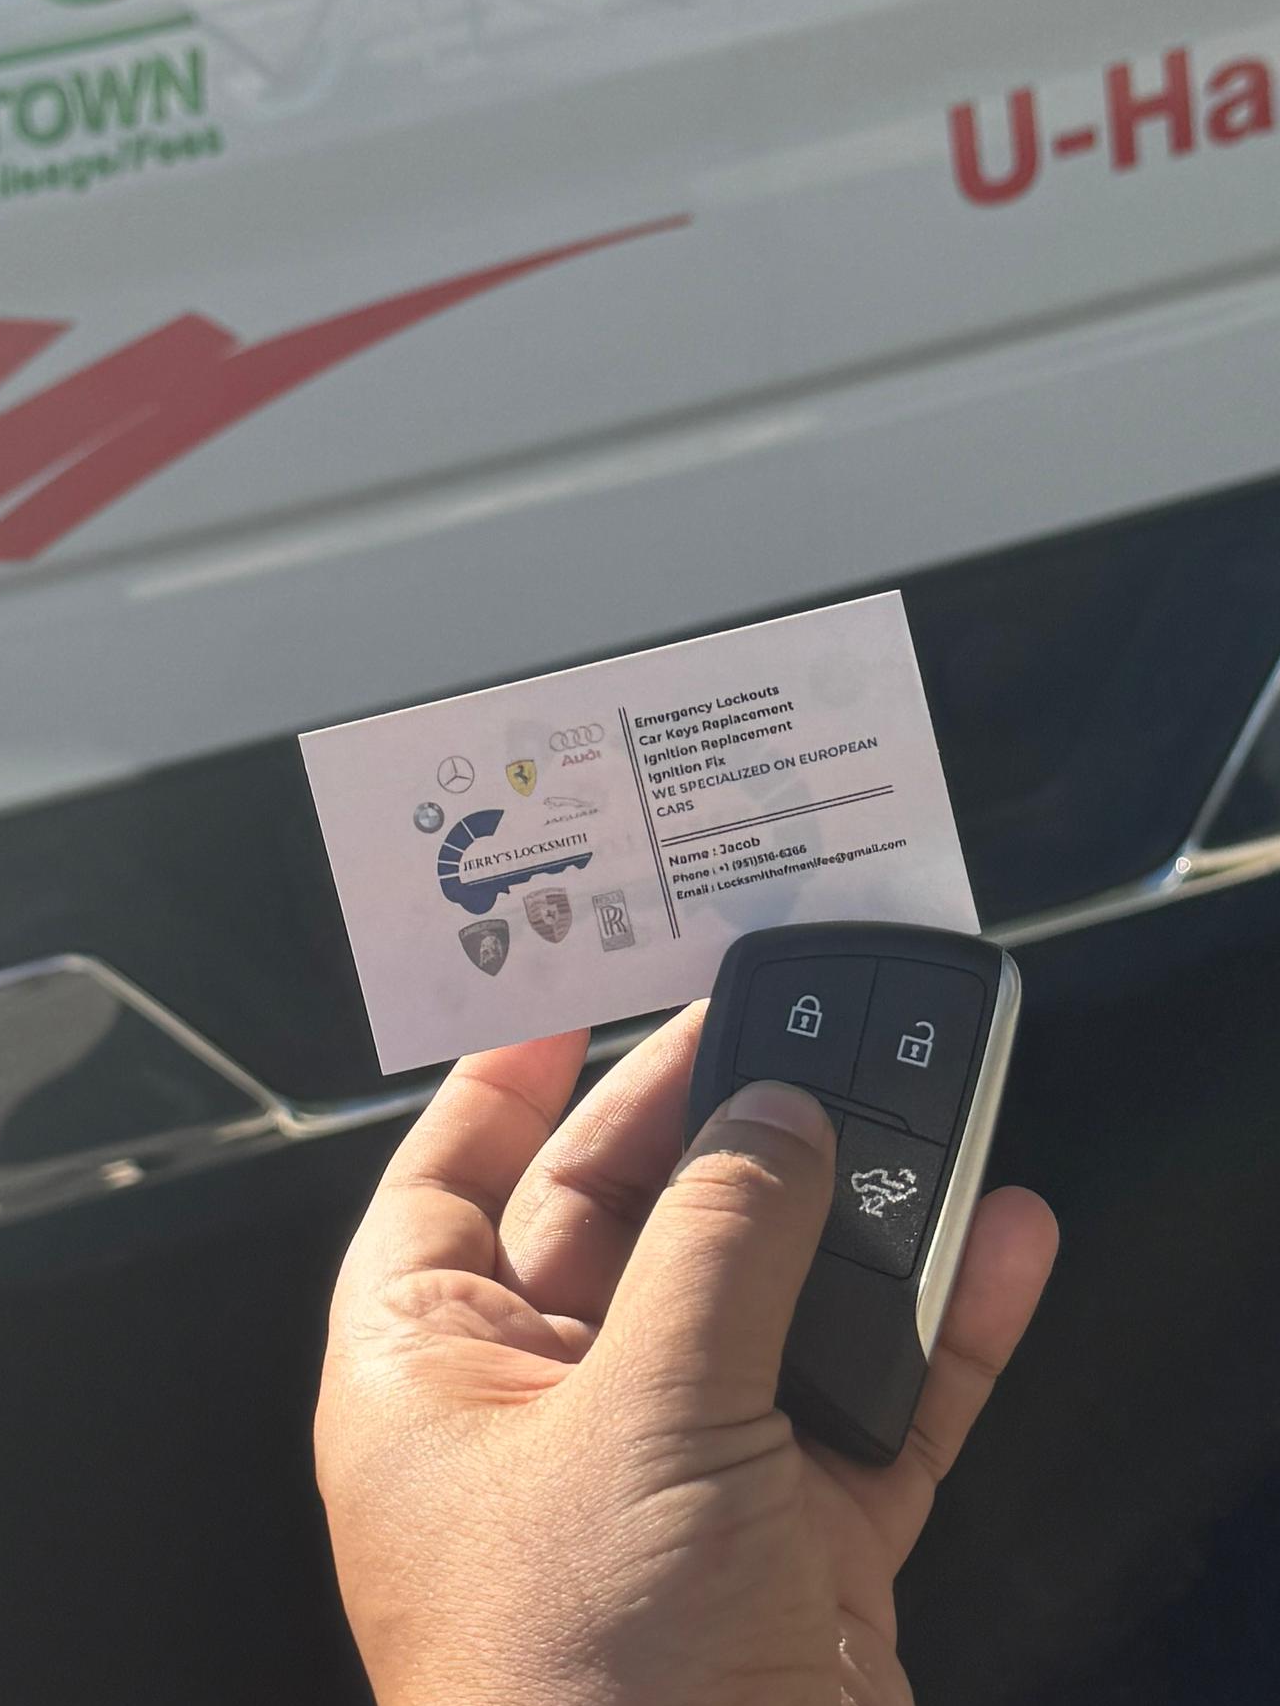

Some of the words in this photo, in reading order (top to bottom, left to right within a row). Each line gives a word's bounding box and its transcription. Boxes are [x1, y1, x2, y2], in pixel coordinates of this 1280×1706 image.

[634, 701, 713, 729] Emergency
[716, 684, 780, 709] Lockouts
[638, 733, 662, 746] Car
[666, 724, 699, 742] Keys
[702, 700, 795, 731] Replacement
[644, 744, 697, 766] Ignition
[700, 719, 794, 750] Replacement
[648, 763, 702, 784] Ignition
[705, 755, 727, 770] Fix
[651, 786, 676, 800] WE
[679, 763, 771, 794] SPECIALIZED
[773, 756, 797, 771] ON
[799, 736, 879, 766] EUROPEAN
[656, 799, 695, 818] CARS
[514, 832, 588, 860] LOCKSMITH
[669, 849, 709, 867] Name
[720, 836, 761, 855] Jacob
[672, 869, 710, 885] Phone
[676, 883, 710, 901] Email
